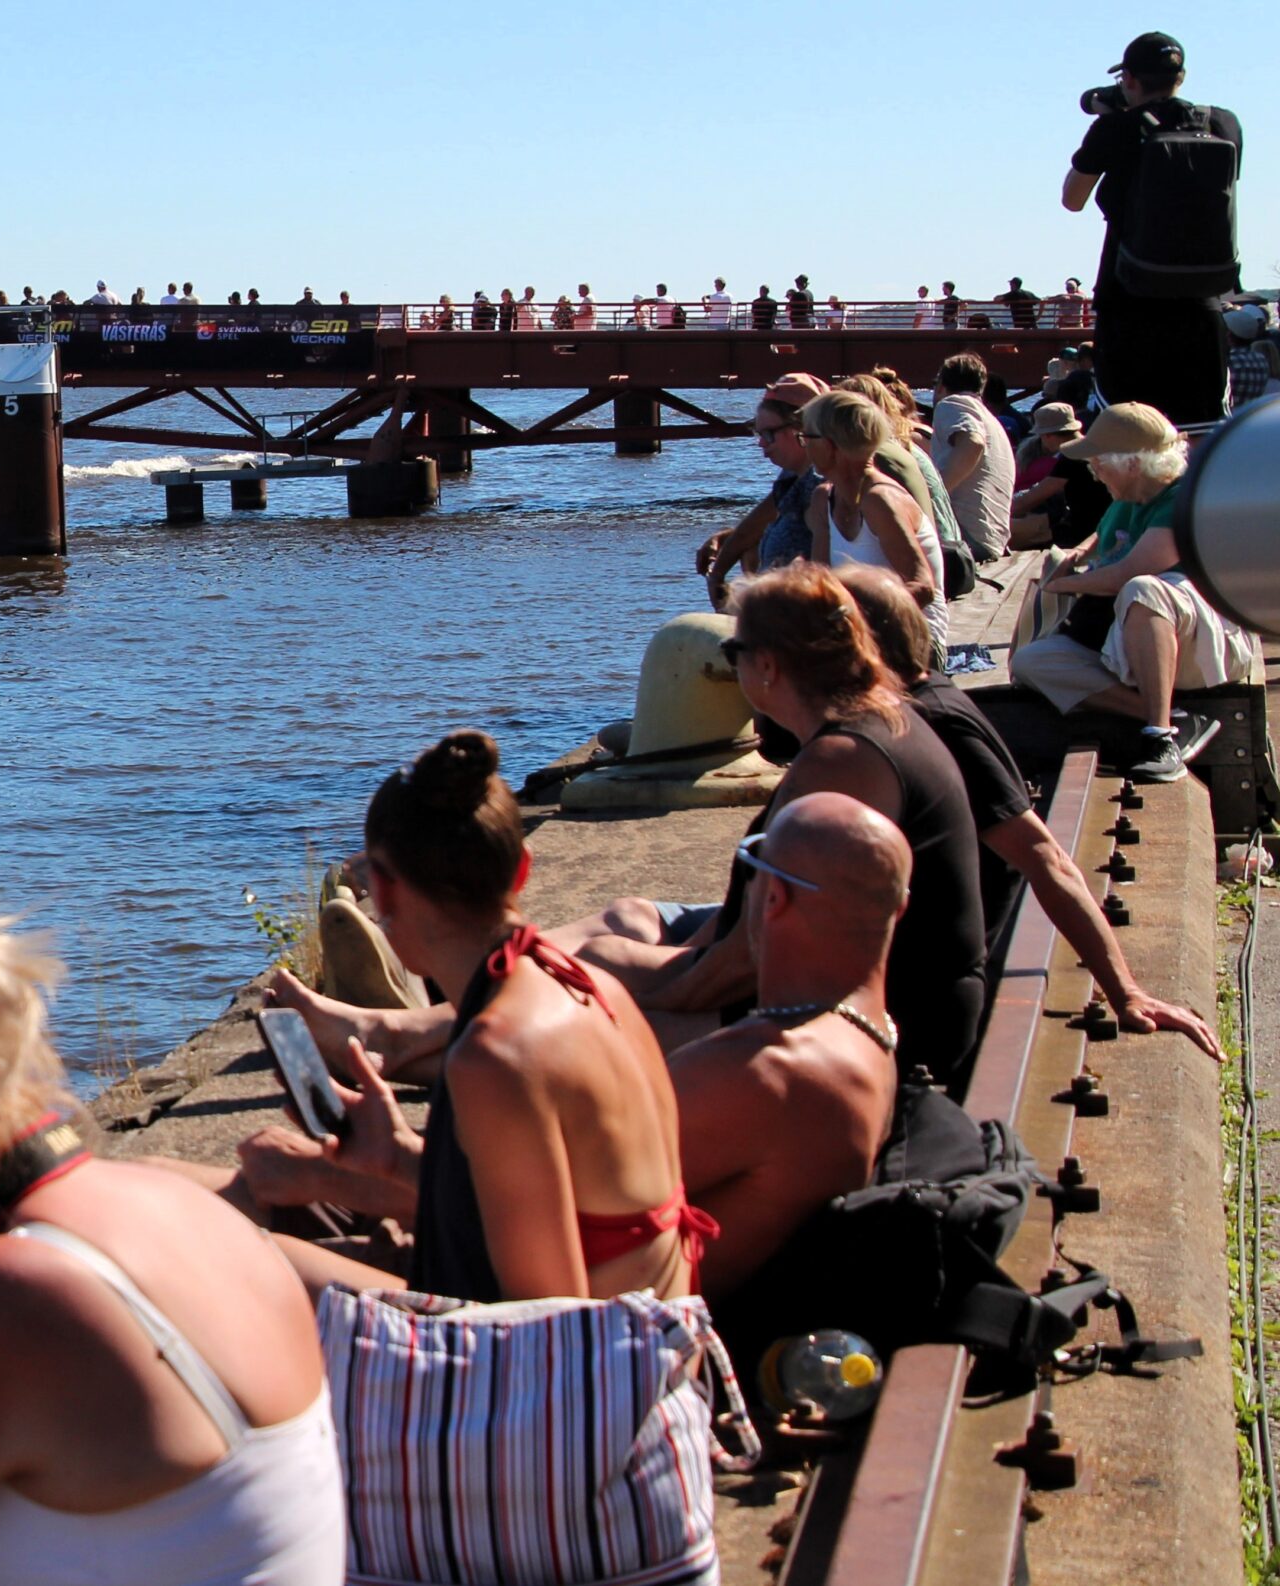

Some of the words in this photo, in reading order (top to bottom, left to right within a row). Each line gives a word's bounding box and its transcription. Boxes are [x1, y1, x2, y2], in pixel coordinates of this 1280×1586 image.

[18, 334, 70, 343] VECAN
[102, 321, 166, 342] VÄSTERÅS
[291, 335, 346, 344] VECKAN
[5, 396, 19, 416] 5
